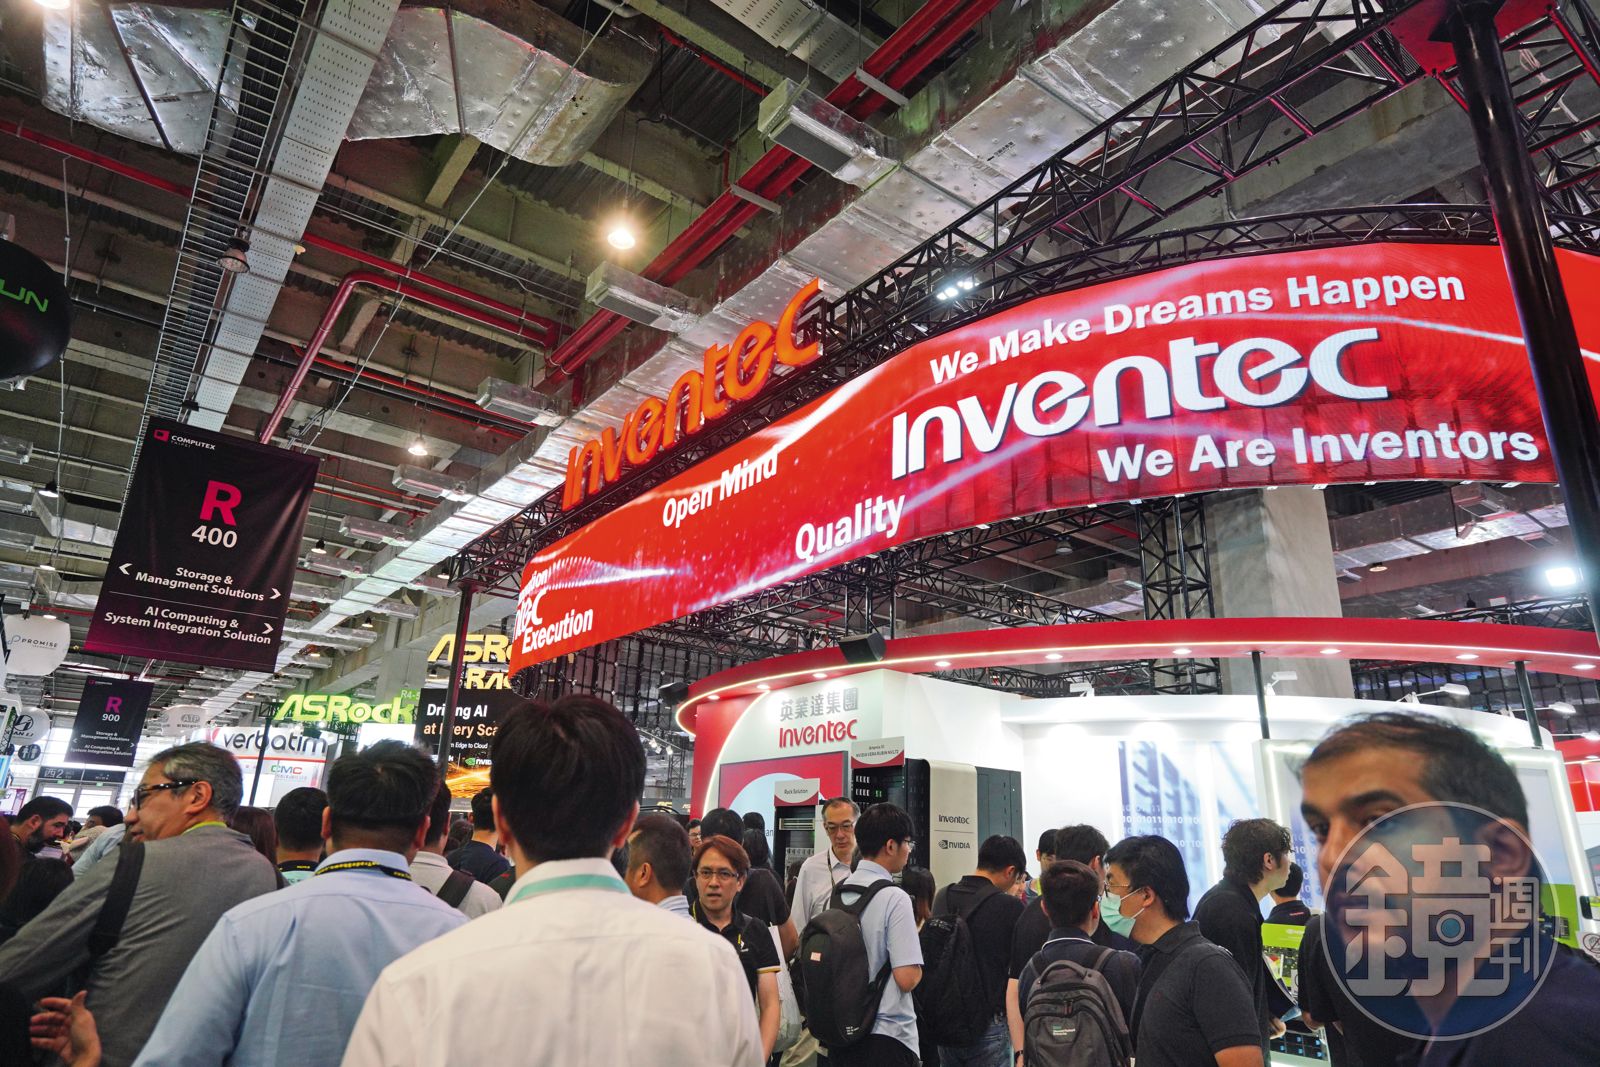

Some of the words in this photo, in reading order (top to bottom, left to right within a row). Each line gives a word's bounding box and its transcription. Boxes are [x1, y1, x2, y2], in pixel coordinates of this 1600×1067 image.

[930, 350, 979, 385] We
[988, 318, 1091, 366] Make
[1104, 285, 1273, 336] Dreams
[1287, 275, 1465, 309] Happen
[561, 276, 824, 512] Inventec
[892, 328, 1389, 481] Inventec
[171, 435, 216, 450] COMPUTEX
[1097, 444, 1174, 483] We
[1189, 434, 1276, 472] Are
[1292, 422, 1540, 462] Inventors
[662, 484, 713, 529] Open
[719, 448, 778, 501] Mind
[200, 480, 242, 527] R
[191, 525, 238, 548] 400
[795, 494, 906, 564] Quality
[135, 572, 208, 592] Managment
[210, 585, 265, 601] Solutions
[176, 567, 222, 584] Storage
[223, 575, 234, 585] &
[104, 612, 151, 627] System
[153, 619, 221, 638] Integration
[223, 629, 271, 645] Solution
[144, 606, 159, 616] AI
[161, 608, 228, 629] Computing
[229, 619, 239, 628] &
[521, 608, 594, 655] Execution
[21, 638, 58, 648] PROMISE
[427, 633, 513, 663] ASR
[102, 713, 121, 722] 900
[105, 696, 122, 713] R
[274, 694, 414, 724] ASRock
[426, 703, 472, 720] Dring
[473, 704, 488, 718] AI
[780, 688, 858, 721] 英業達集團
[423, 722, 437, 735] at
[779, 719, 858, 748] Inventec
[455, 741, 468, 749] Edge
[938, 814, 970, 825] Inventec
[948, 841, 971, 849] NVIDIA
